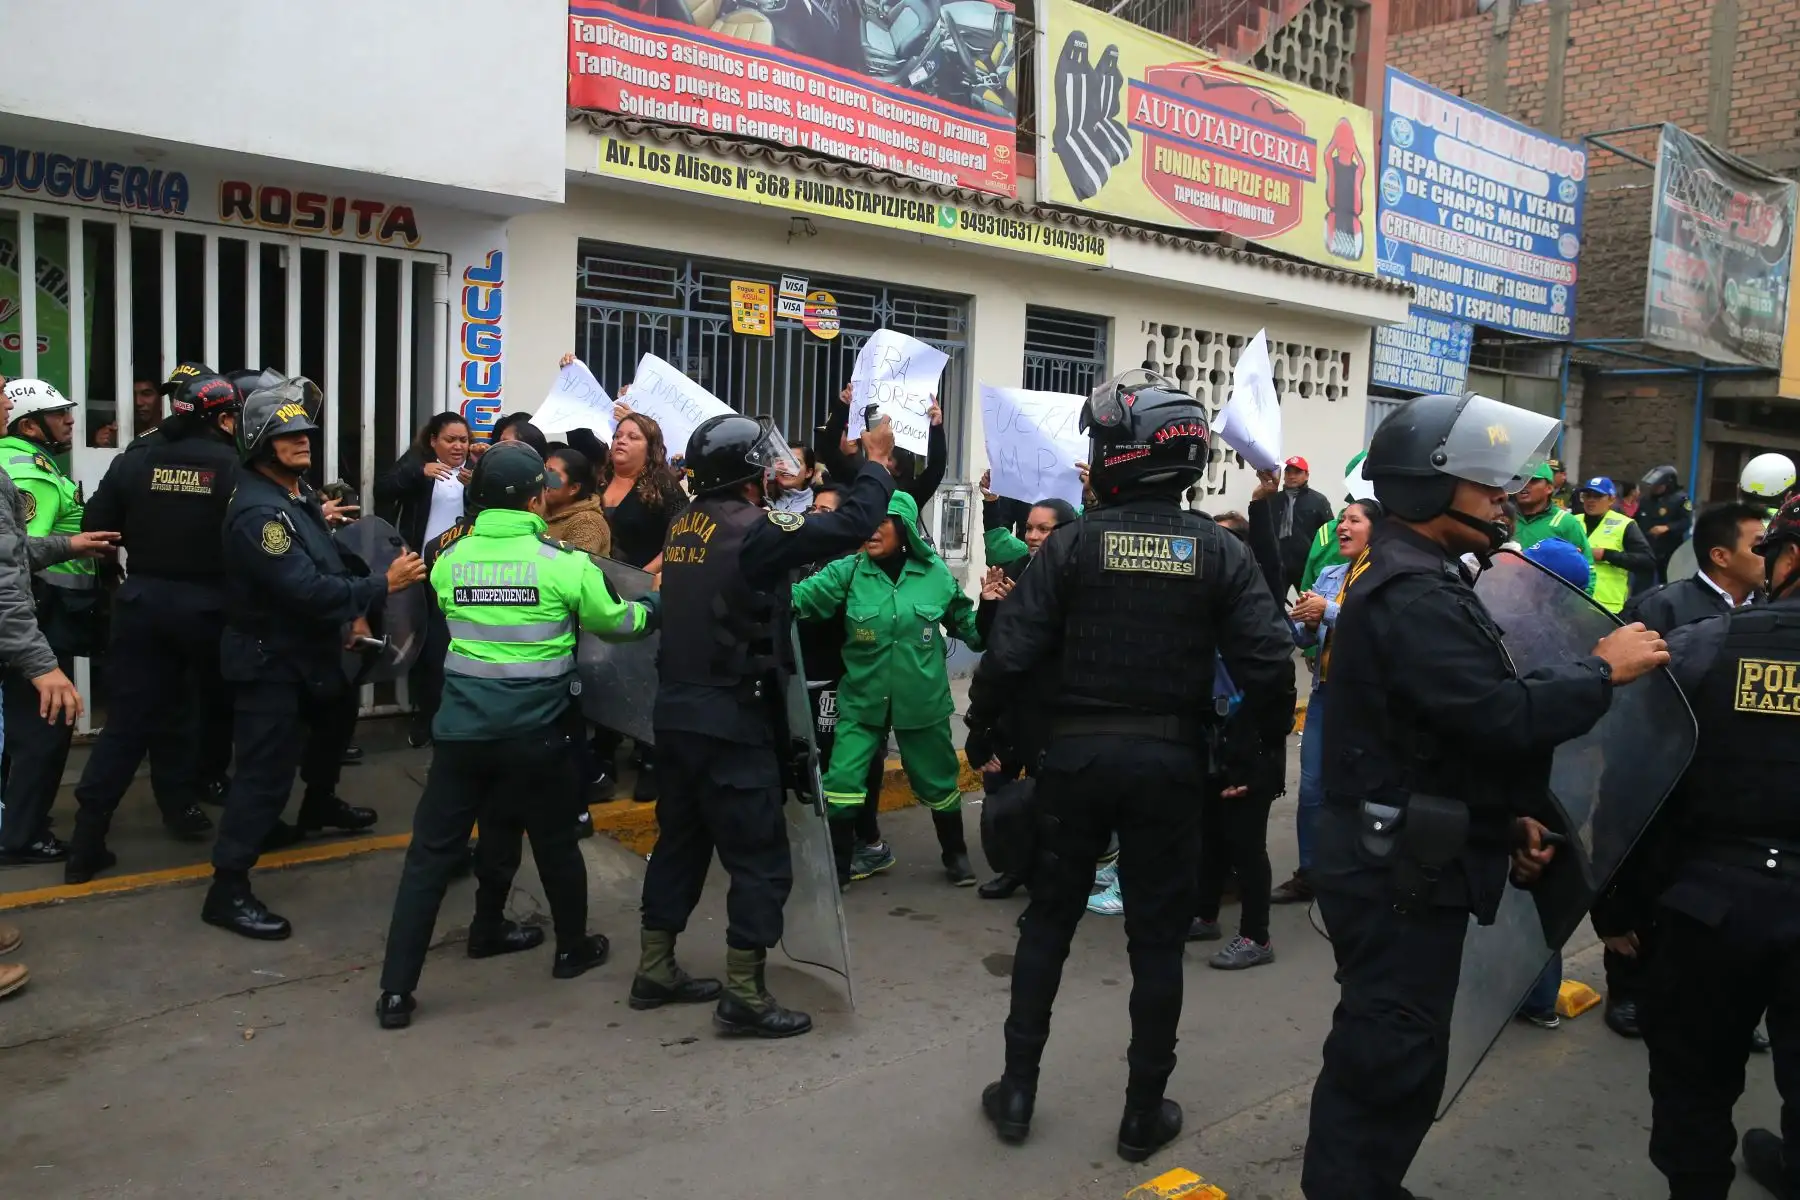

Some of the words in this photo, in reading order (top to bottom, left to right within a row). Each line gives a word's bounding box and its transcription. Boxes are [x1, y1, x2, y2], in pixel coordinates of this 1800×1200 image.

[572, 19, 668, 60] Tapizamos
[671, 43, 744, 78] asientos
[748, 61, 769, 82] de
[772, 68, 805, 92] auto
[808, 80, 826, 98] en
[828, 87, 870, 113] cuero,
[576, 52, 671, 90] Tapizamos
[674, 74, 743, 108] puertas,
[747, 90, 793, 118] pisos,
[796, 102, 855, 133] tableros
[857, 120, 866, 138] y
[867, 124, 920, 154] muebles
[921, 140, 937, 157] en
[937, 145, 987, 171] general
[619, 89, 709, 126] Soldadura
[711, 112, 732, 131] en
[736, 114, 798, 144] General
[800, 132, 809, 147] y
[811, 131, 887, 168] Reparación
[905, 160, 958, 187] Asientos
[1136, 94, 1312, 173] AUTOTAPICERIA
[605, 138, 634, 167] Av.
[638, 145, 671, 174] Los
[675, 153, 732, 187] Alisos
[960, 210, 1033, 242] 949310531
[1042, 226, 1105, 256] 914793148
[1154, 145, 1211, 186] FUNDAS
[1264, 178, 1291, 206] CAR
[1388, 144, 1509, 206] REPARACION
[1513, 190, 1525, 210] Y
[1526, 195, 1576, 225] VENTA
[218, 180, 421, 248] ROSITA
[1406, 175, 1428, 199] DE
[1431, 184, 1495, 220] CHAPAS
[1498, 208, 1560, 239] MANIJAS
[1385, 213, 1466, 257] CREMALLERAS
[1466, 239, 1509, 269] MANUAL
[1518, 253, 1572, 283] ELECTRICAS
[1438, 208, 1450, 227] Y
[1452, 213, 1534, 251] CONTACTO
[785, 281, 804, 293] VISA
[1411, 252, 1462, 285] DUPLICADO
[1463, 266, 1474, 289] DE
[1504, 277, 1515, 299] EN
[1516, 281, 1547, 306] GENERAL
[783, 301, 801, 312] VISA
[1456, 293, 1465, 316] Y
[1465, 297, 1511, 327] ESPEJOS
[1512, 307, 1570, 336] ORIGINALES
[152, 467, 200, 486] POLICIA
[670, 511, 717, 544] POLICIA
[1108, 535, 1171, 559] POLICIA
[452, 562, 538, 586] POLICIA
[665, 546, 686, 562] SOES
[688, 547, 706, 564] N-2
[1108, 558, 1192, 573] HALCONES
[472, 588, 537, 603] INDEPENDENCIA
[1742, 663, 1800, 693] POL
